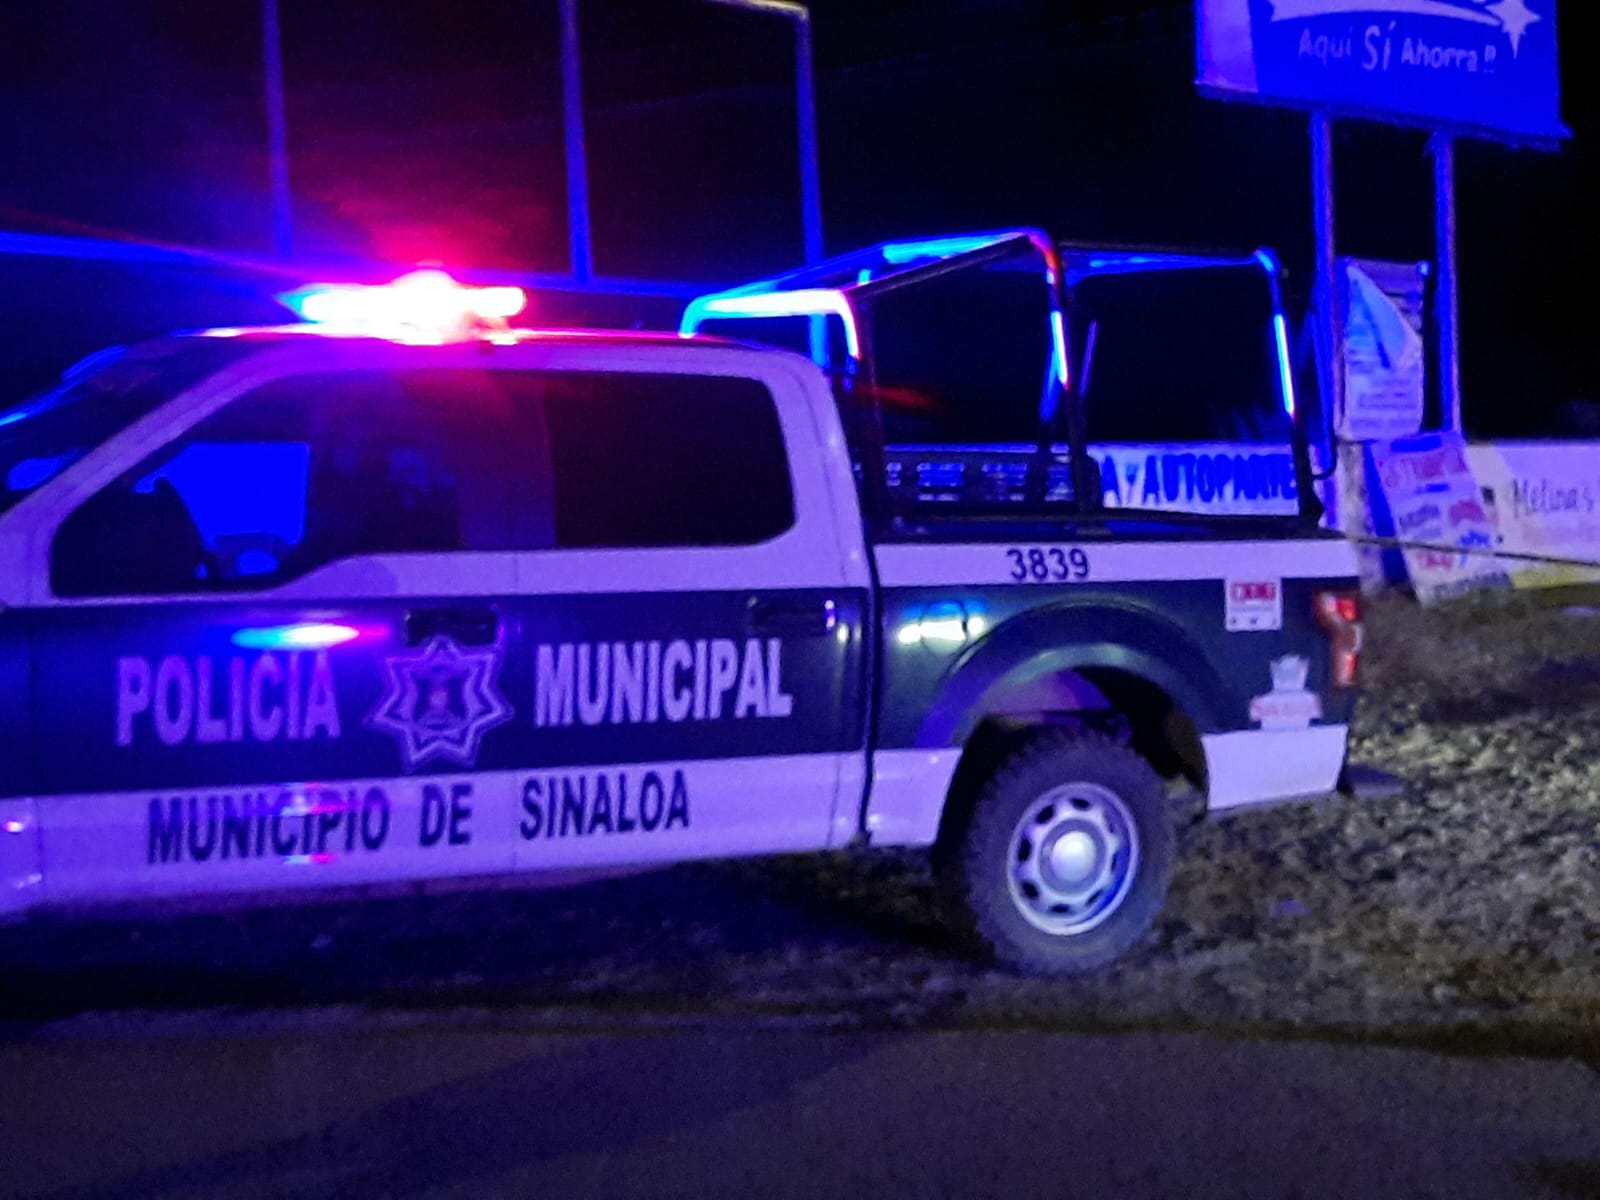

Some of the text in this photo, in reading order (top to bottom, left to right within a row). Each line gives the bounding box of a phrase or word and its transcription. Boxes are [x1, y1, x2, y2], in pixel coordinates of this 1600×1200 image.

[1361, 21, 1397, 72] Sí
[1006, 548, 1089, 582] 3839
[114, 637, 793, 747] POLICIA MUNICIPAL
[147, 769, 691, 865] MUNICIPIO DE SINALOA
